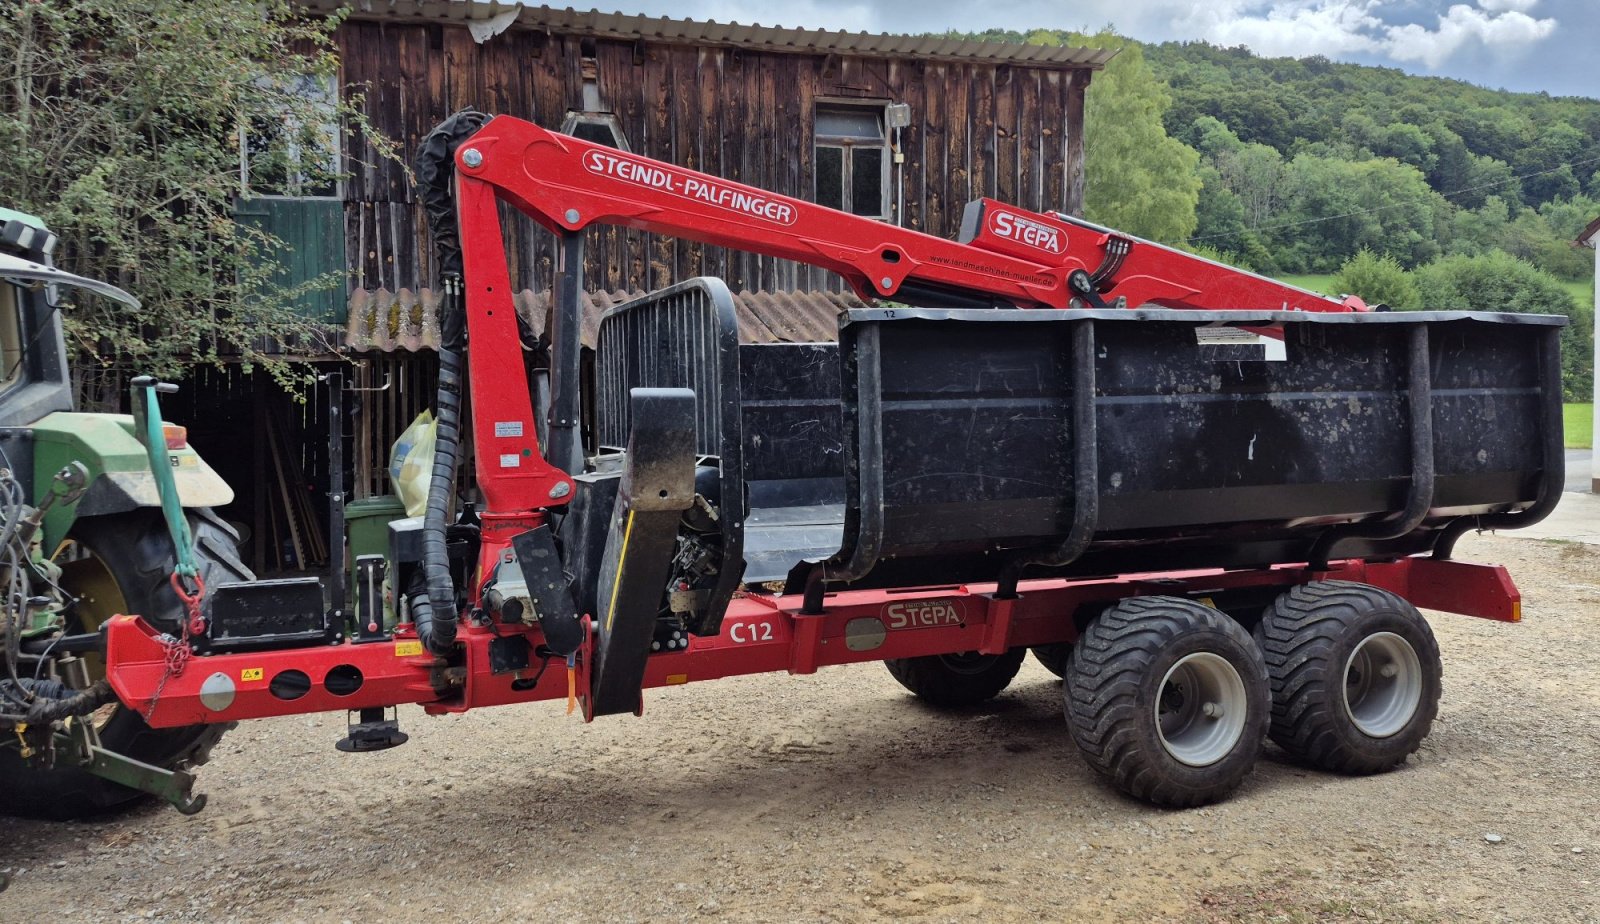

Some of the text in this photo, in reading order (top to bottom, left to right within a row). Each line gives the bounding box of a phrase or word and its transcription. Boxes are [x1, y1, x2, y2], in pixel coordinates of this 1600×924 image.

[590, 152, 791, 223] STEINDL-PALFINGER
[994, 212, 1059, 253] STEPA
[930, 255, 1053, 287] www.landmaschinen-mueller.de
[883, 310, 897, 318] 12
[887, 603, 960, 628] STEPA
